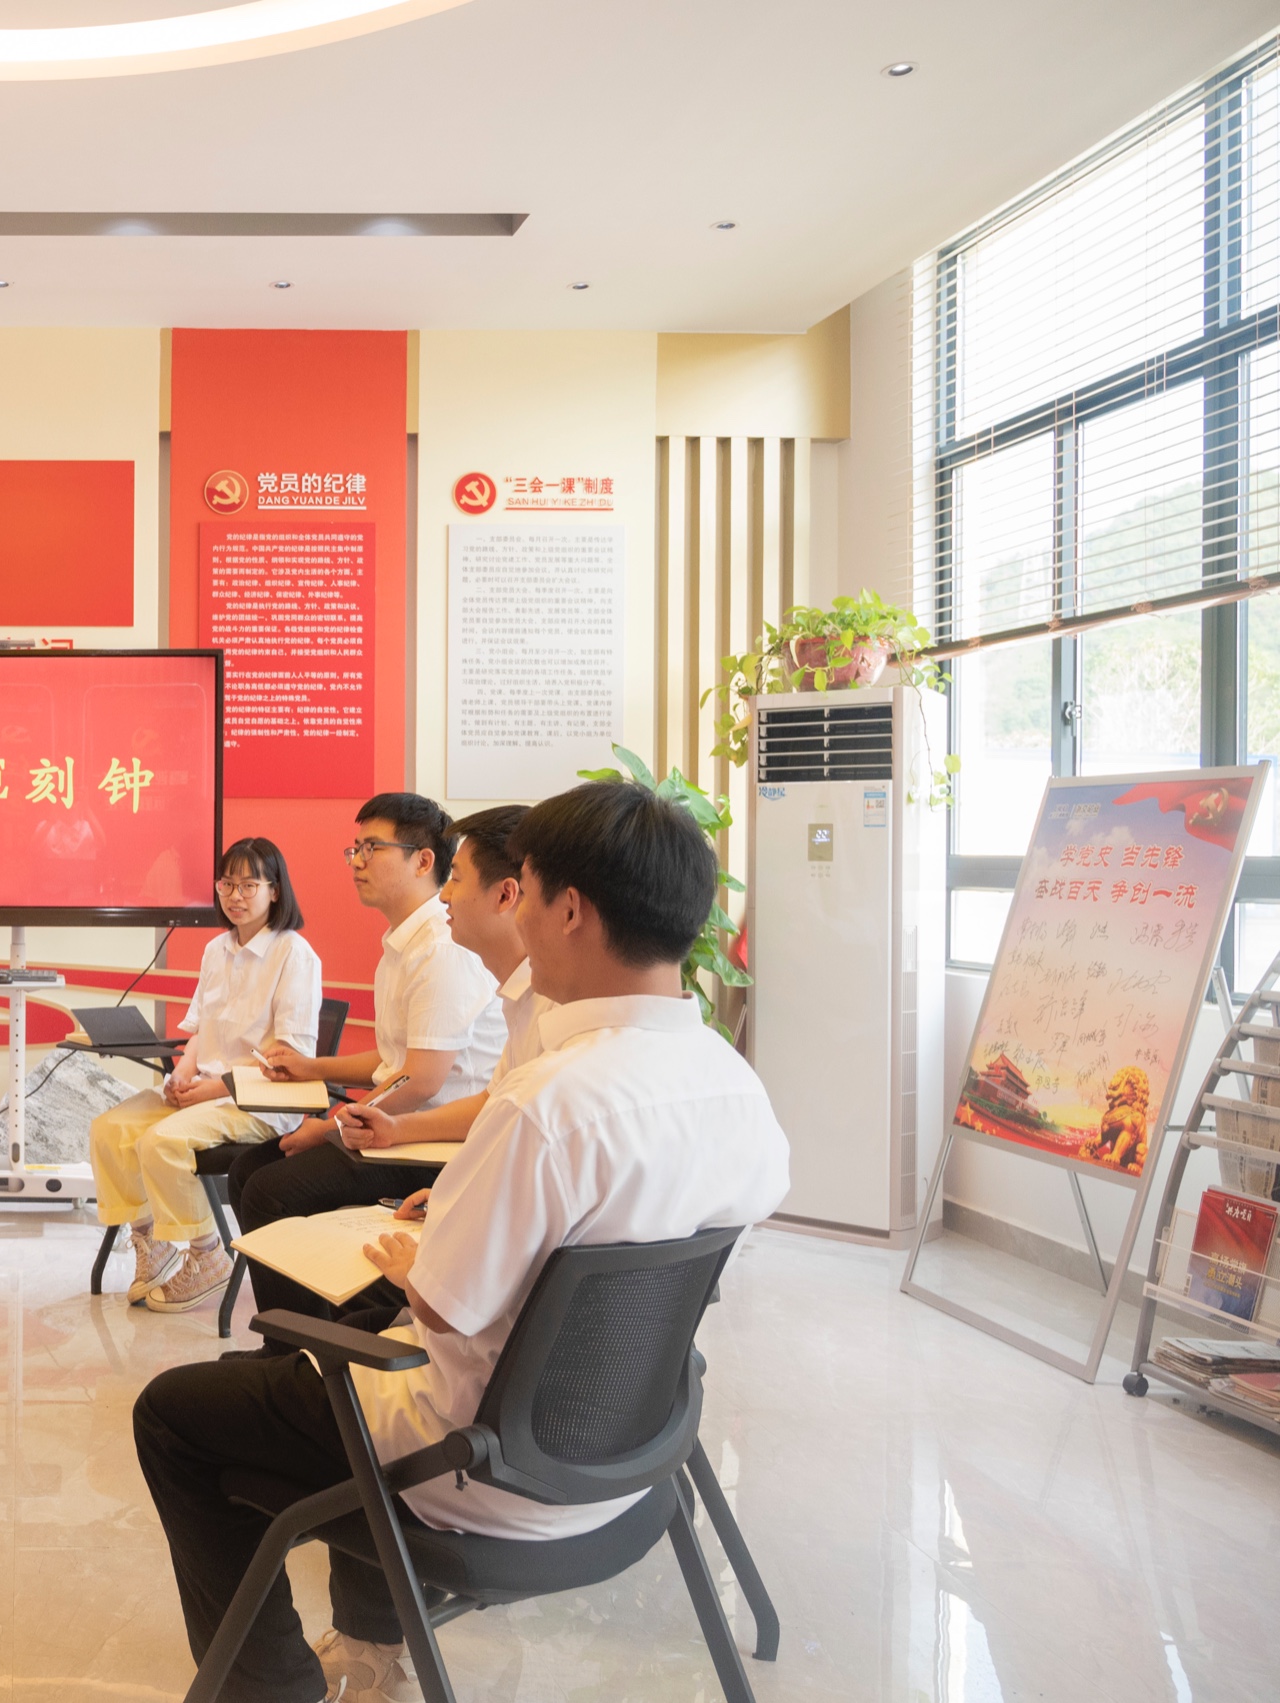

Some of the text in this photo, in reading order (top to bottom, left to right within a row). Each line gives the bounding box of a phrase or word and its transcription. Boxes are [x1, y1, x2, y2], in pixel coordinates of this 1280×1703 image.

[257, 472, 367, 494] 党员的纪律
[504, 477, 614, 495] “三会一课”制度
[258, 496, 365, 505] DANG YUAN DE JILV
[1059, 843, 1185, 871] 学党史 当先锋
[1034, 878, 1199, 909] 奋战百天 争创一流
[1206, 1266, 1243, 1290] 勇立潮头
